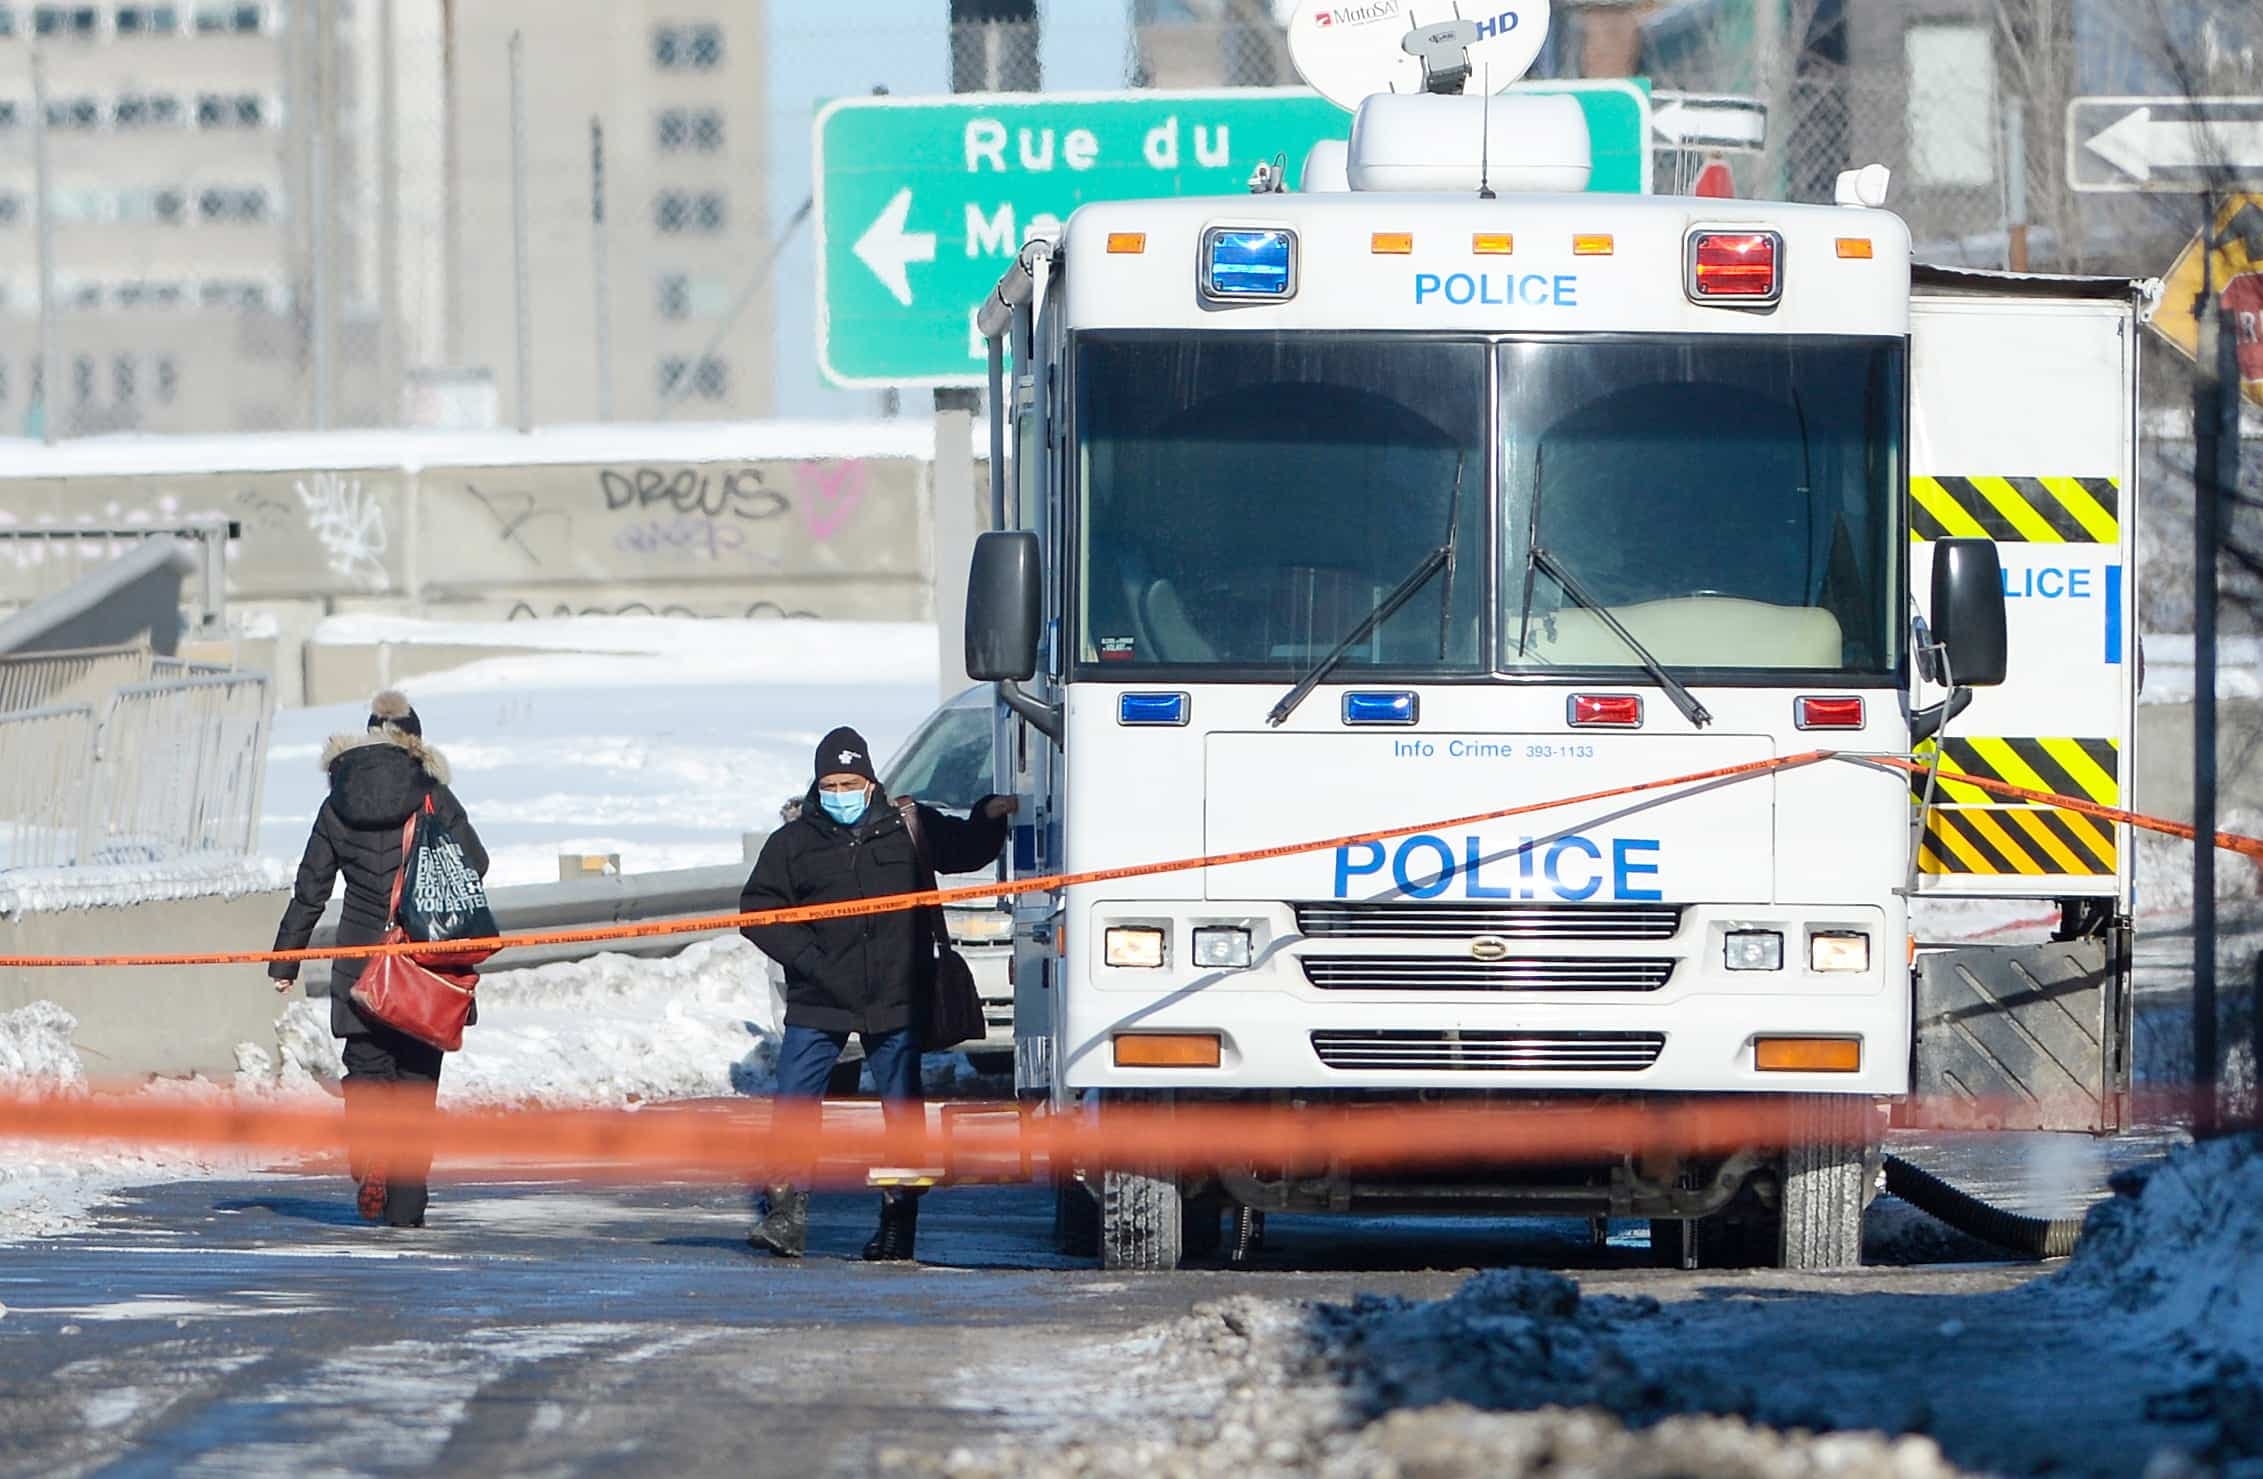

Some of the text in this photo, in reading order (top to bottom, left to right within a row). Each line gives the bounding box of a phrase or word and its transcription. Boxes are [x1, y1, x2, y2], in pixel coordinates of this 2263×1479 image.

[1475, 11, 1519, 41] HD
[965, 116, 1230, 172] Rue du
[1416, 273, 1579, 306] POLICE
[2001, 568, 2091, 598] LICE
[1394, 739, 1594, 759] Info Crime 393-1133
[1334, 835, 1663, 901] POLICE
